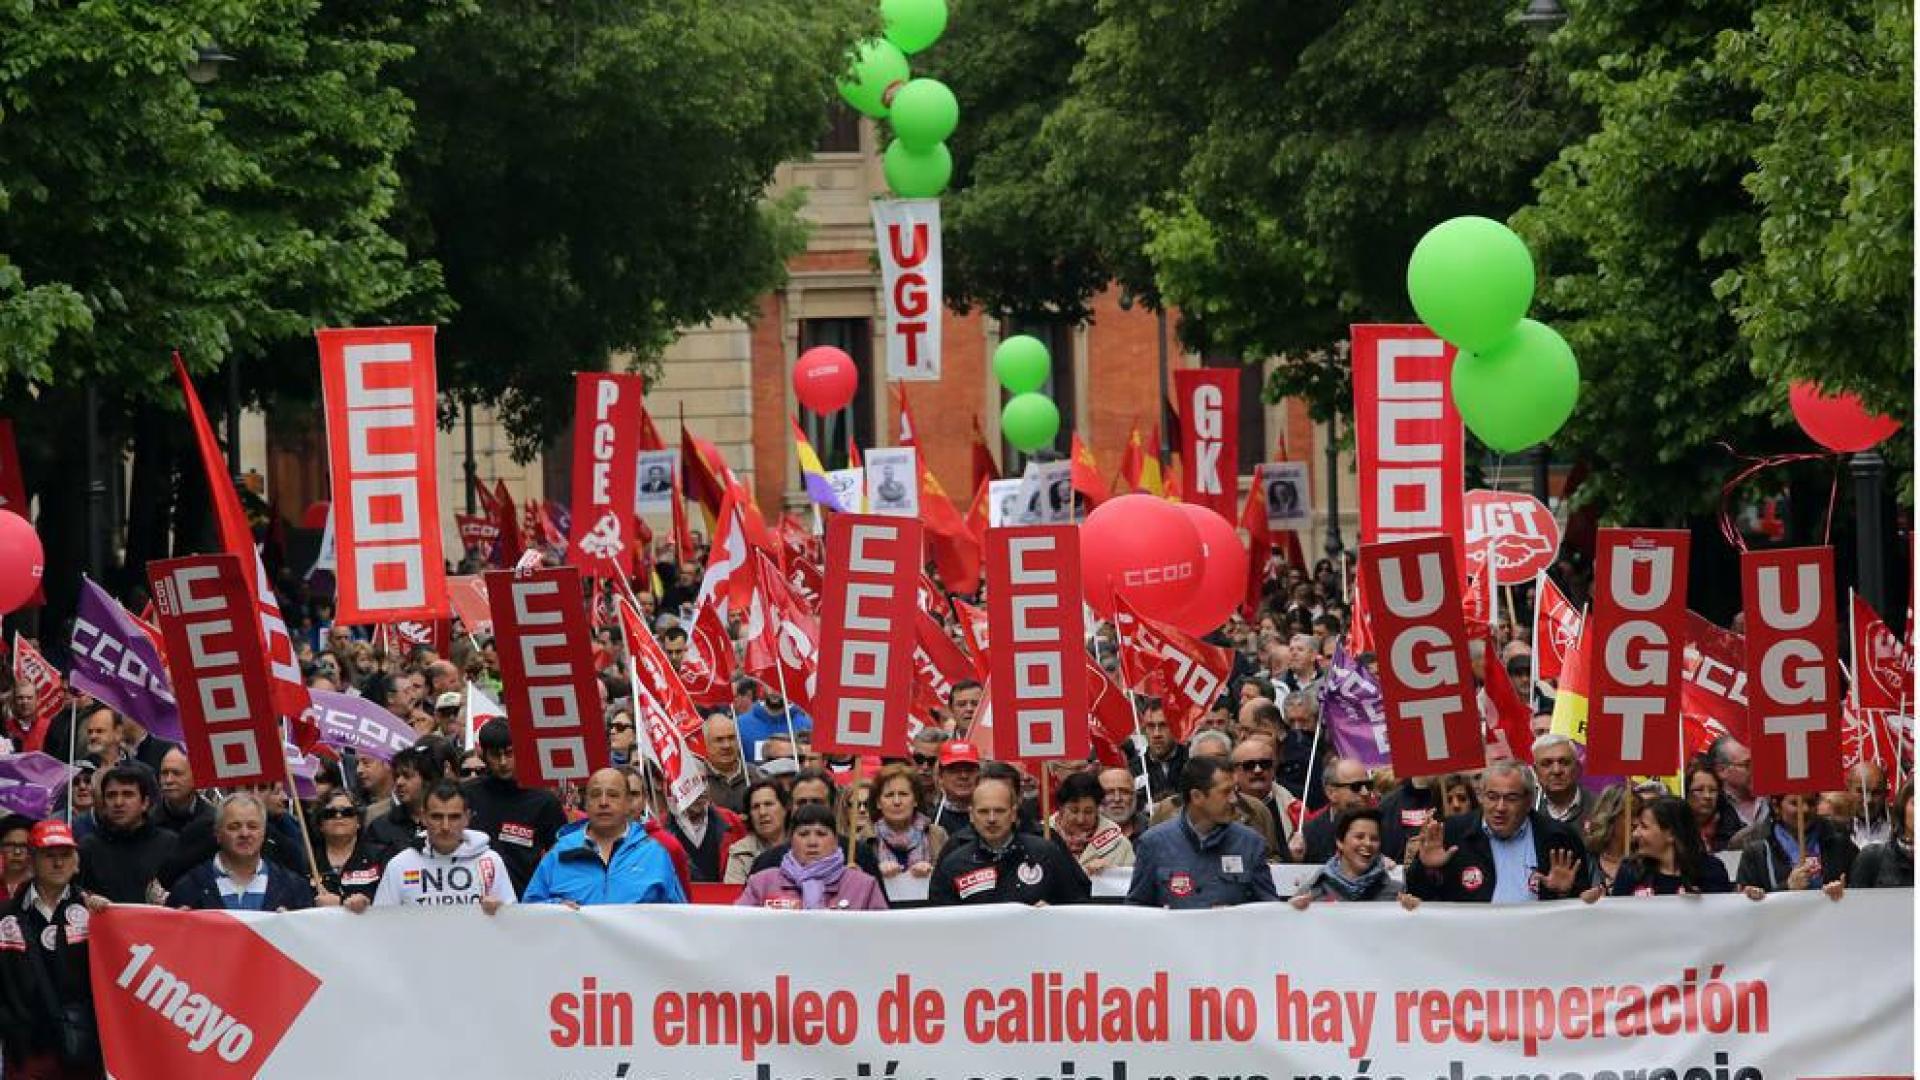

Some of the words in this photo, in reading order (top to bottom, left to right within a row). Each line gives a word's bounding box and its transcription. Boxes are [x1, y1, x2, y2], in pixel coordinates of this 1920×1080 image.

[888, 223, 929, 367] UGT
[342, 342, 426, 610] CCOO
[593, 379, 619, 505] PCE
[1193, 384, 1223, 495] GK
[1377, 339, 1443, 544] CCO
[173, 565, 263, 779] CCOO
[837, 524, 899, 746] CCOO
[1008, 536, 1066, 757] CCOO
[1124, 562, 1191, 587] CCOO
[1378, 552, 1464, 760] UGT
[1605, 546, 1674, 761] UGT
[1757, 563, 1827, 780] UGT
[511, 581, 590, 780] CCOO
[420, 867, 472, 893] NO
[959, 869, 997, 887] CCOO
[115, 942, 154, 989] 1
[137, 966, 254, 1065] mayo
[550, 976, 633, 1047] sin
[653, 974, 858, 1061] empleo
[877, 973, 945, 1044] de
[964, 971, 1168, 1044] calidad
[1188, 985, 1257, 1042] no
[1275, 974, 1377, 1059] hay
[1394, 964, 1770, 1057] recuperación
